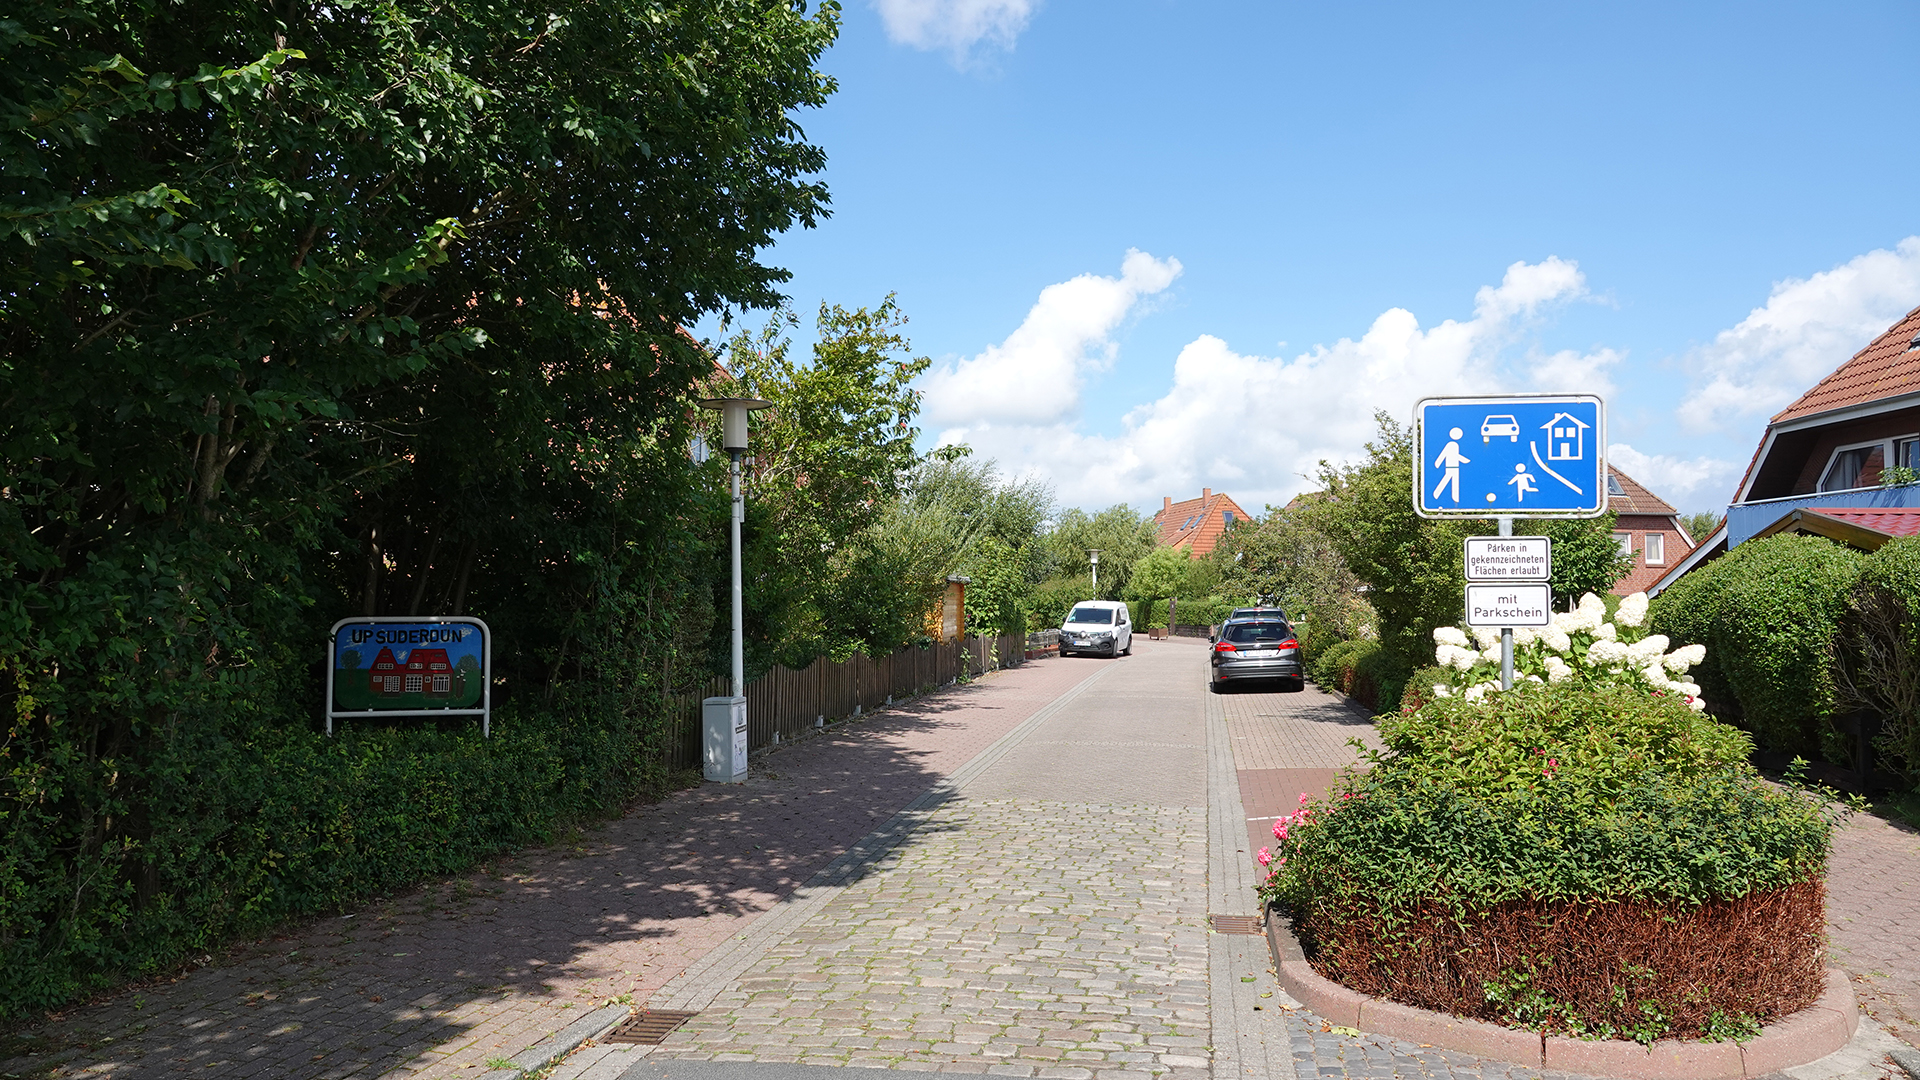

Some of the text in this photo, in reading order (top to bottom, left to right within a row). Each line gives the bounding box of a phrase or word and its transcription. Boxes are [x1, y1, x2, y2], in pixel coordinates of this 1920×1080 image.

[1487, 543, 1527, 552] Parken in
[1471, 555, 1544, 566] gekennzeichneten
[1475, 565, 1540, 575] Flächen erlaubt
[1498, 594, 1517, 604] mit
[1474, 607, 1542, 617] Parkschein
[352, 629, 374, 644] UP
